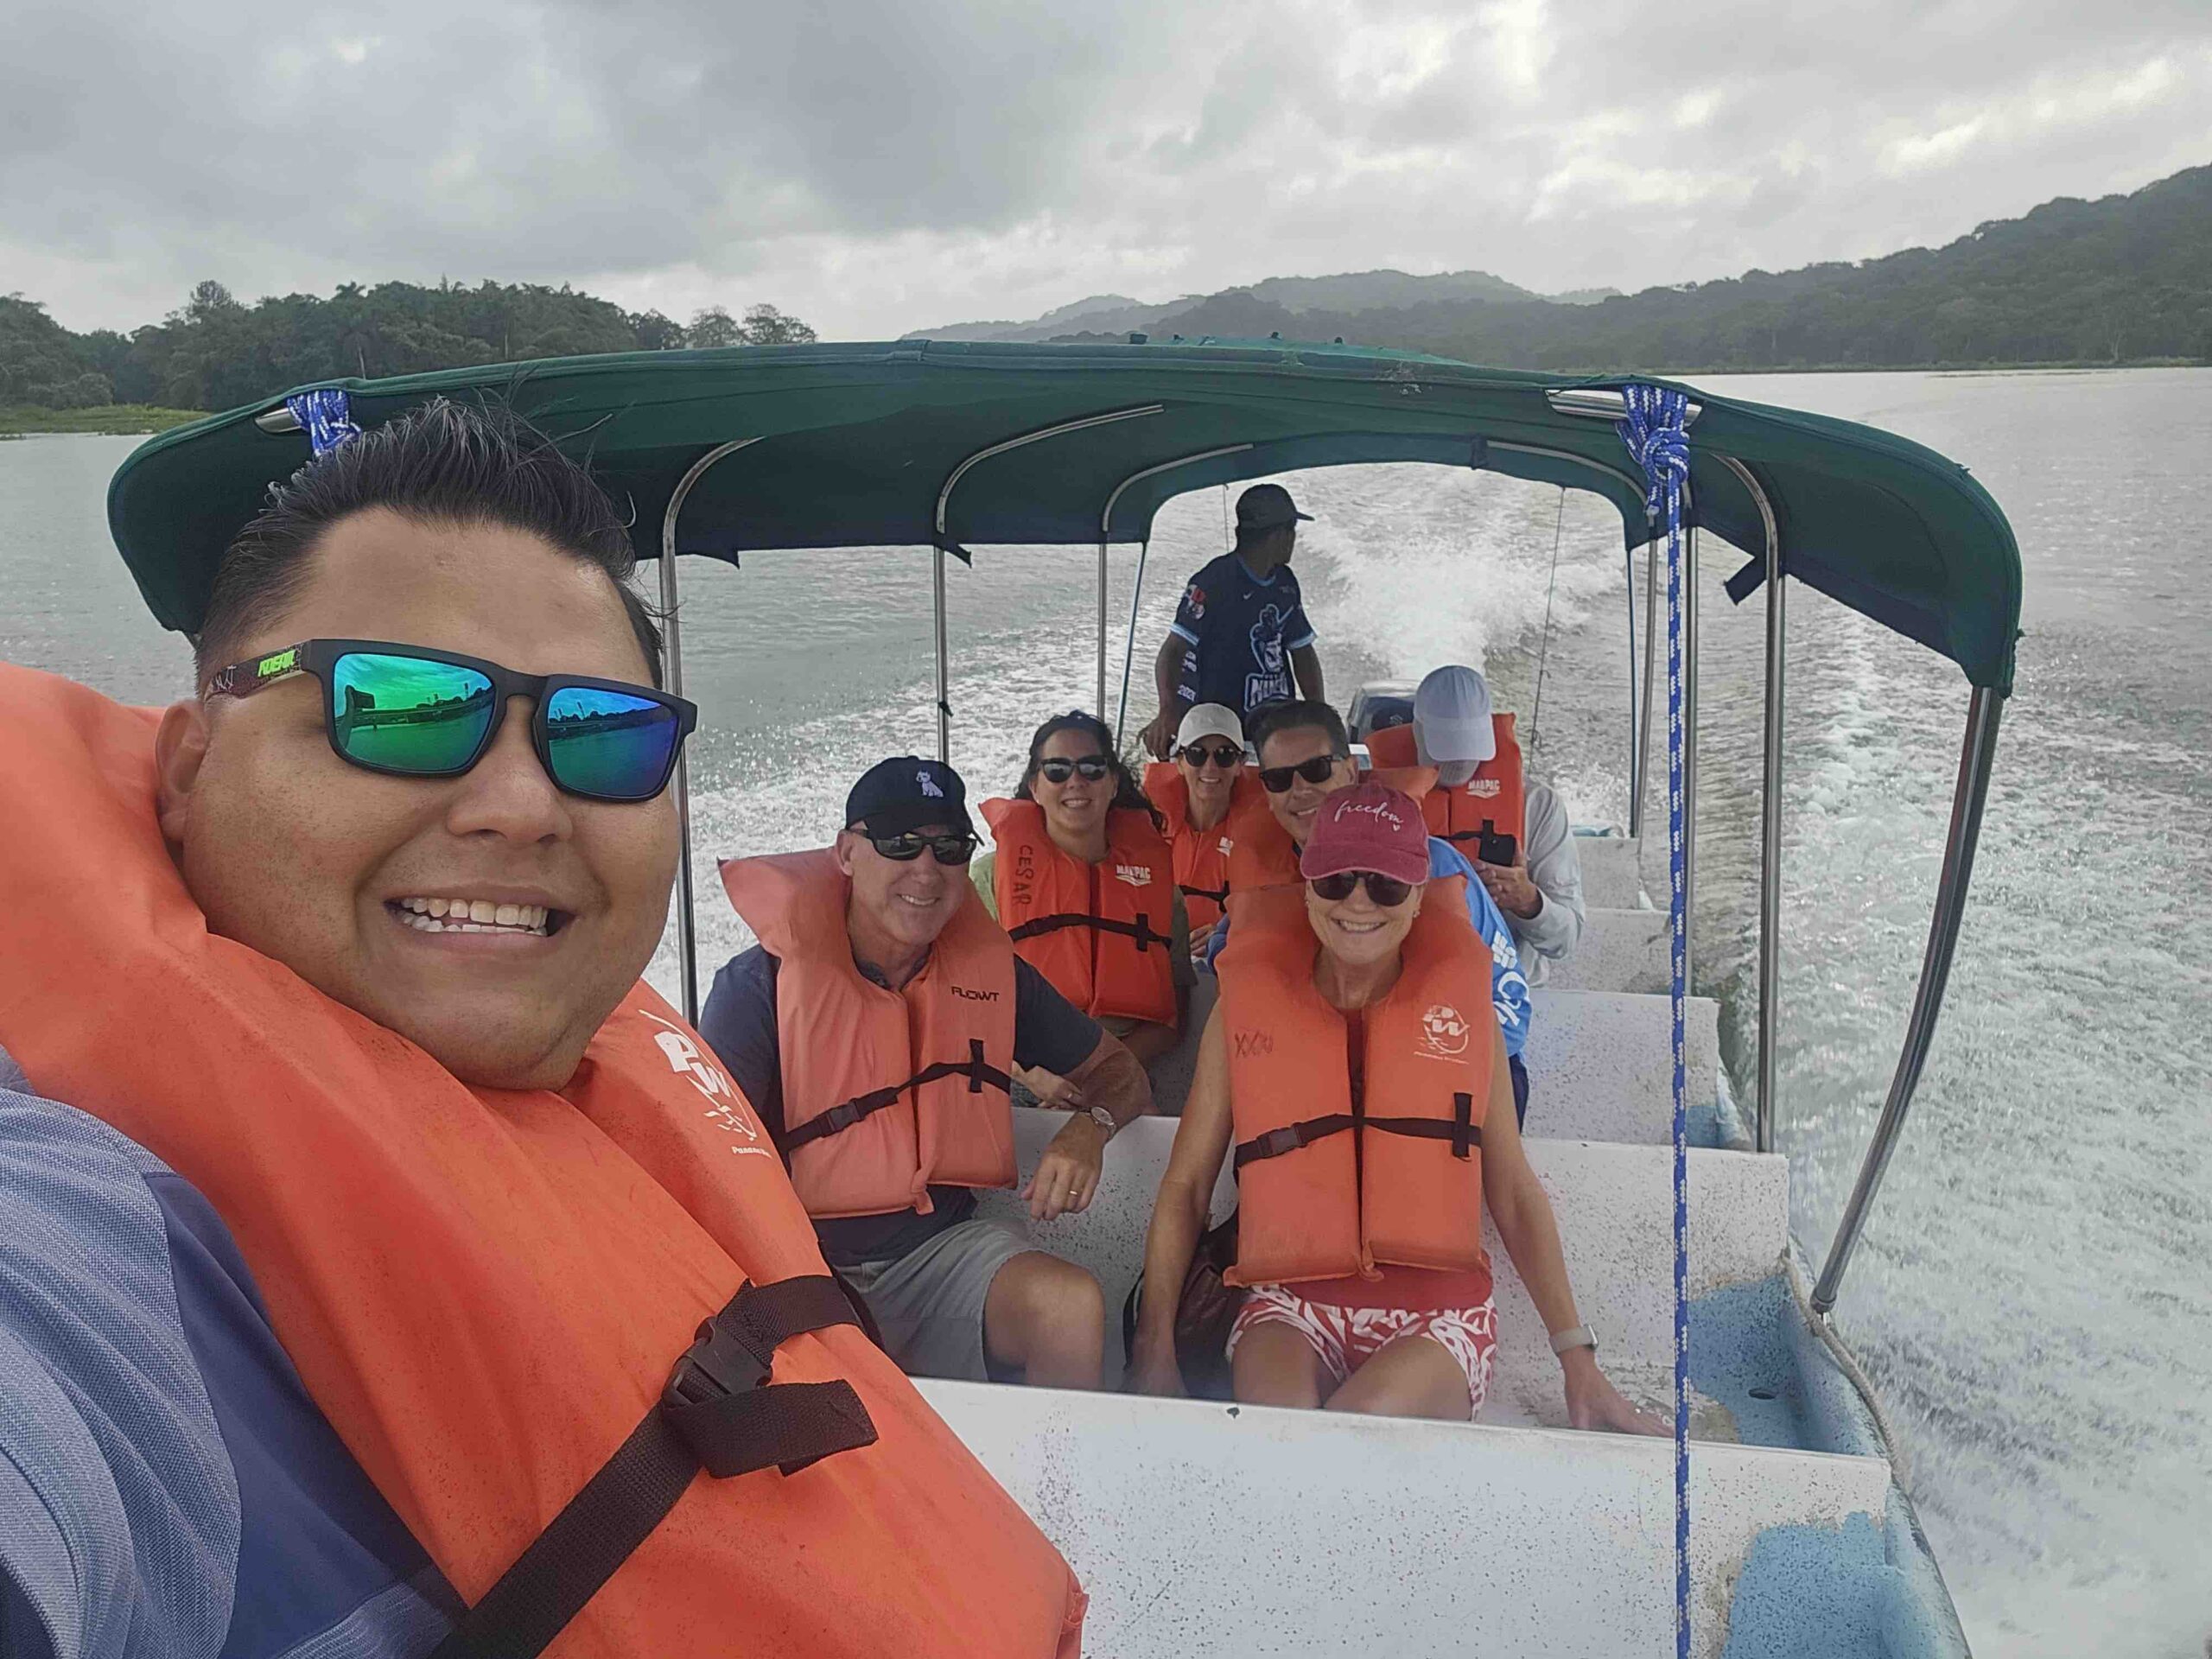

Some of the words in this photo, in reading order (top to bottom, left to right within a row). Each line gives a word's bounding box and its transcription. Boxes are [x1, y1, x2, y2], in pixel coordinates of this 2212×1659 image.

[1334, 799, 1403, 823] freedom
[1012, 844, 1034, 906] CESAR
[951, 986, 1000, 1001] FLOWT
